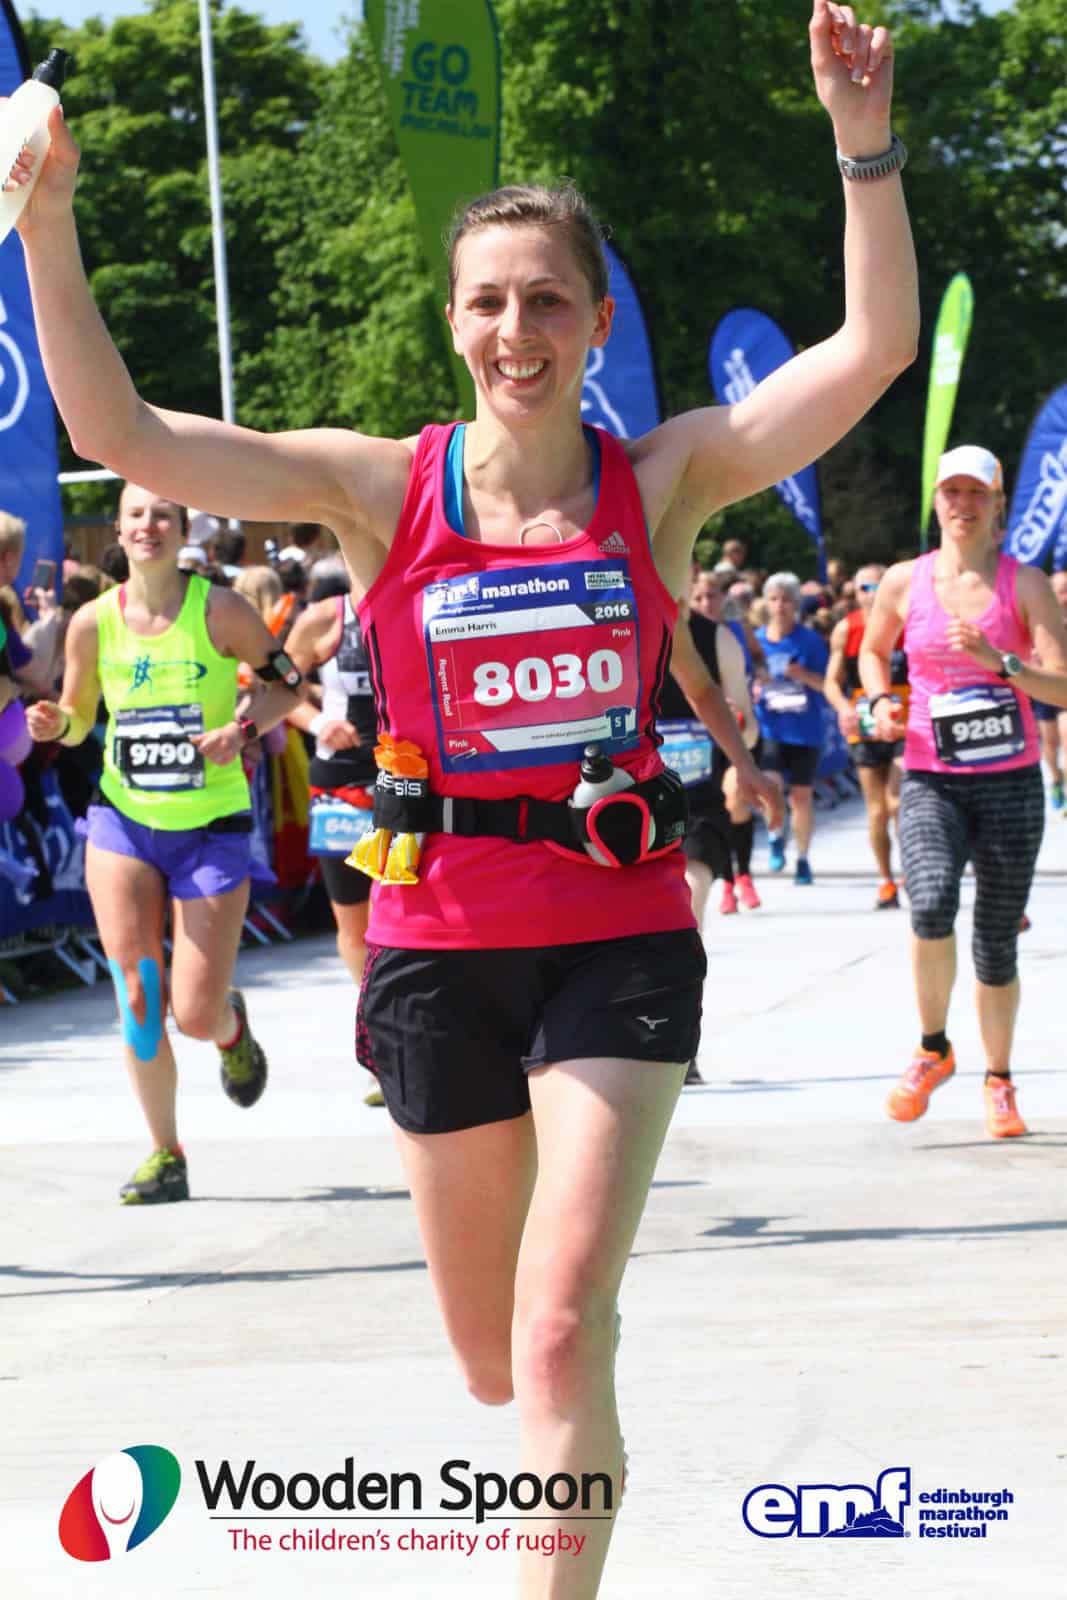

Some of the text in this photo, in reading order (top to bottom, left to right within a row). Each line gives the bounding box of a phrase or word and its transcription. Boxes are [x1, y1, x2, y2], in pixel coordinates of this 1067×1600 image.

[411, 41, 471, 86] GO
[401, 81, 479, 118] TEAM
[598, 544, 630, 554] adidas
[482, 577, 570, 600] marathon
[594, 604, 630, 620] 2016
[434, 621, 497, 636] Emma Harris
[612, 627, 631, 638] Pink
[438, 658, 454, 717] Regent Road
[473, 649, 623, 707] 8030
[951, 714, 1014, 743] 9281
[129, 742, 196, 767] 9790
[449, 739, 469, 749] Pink
